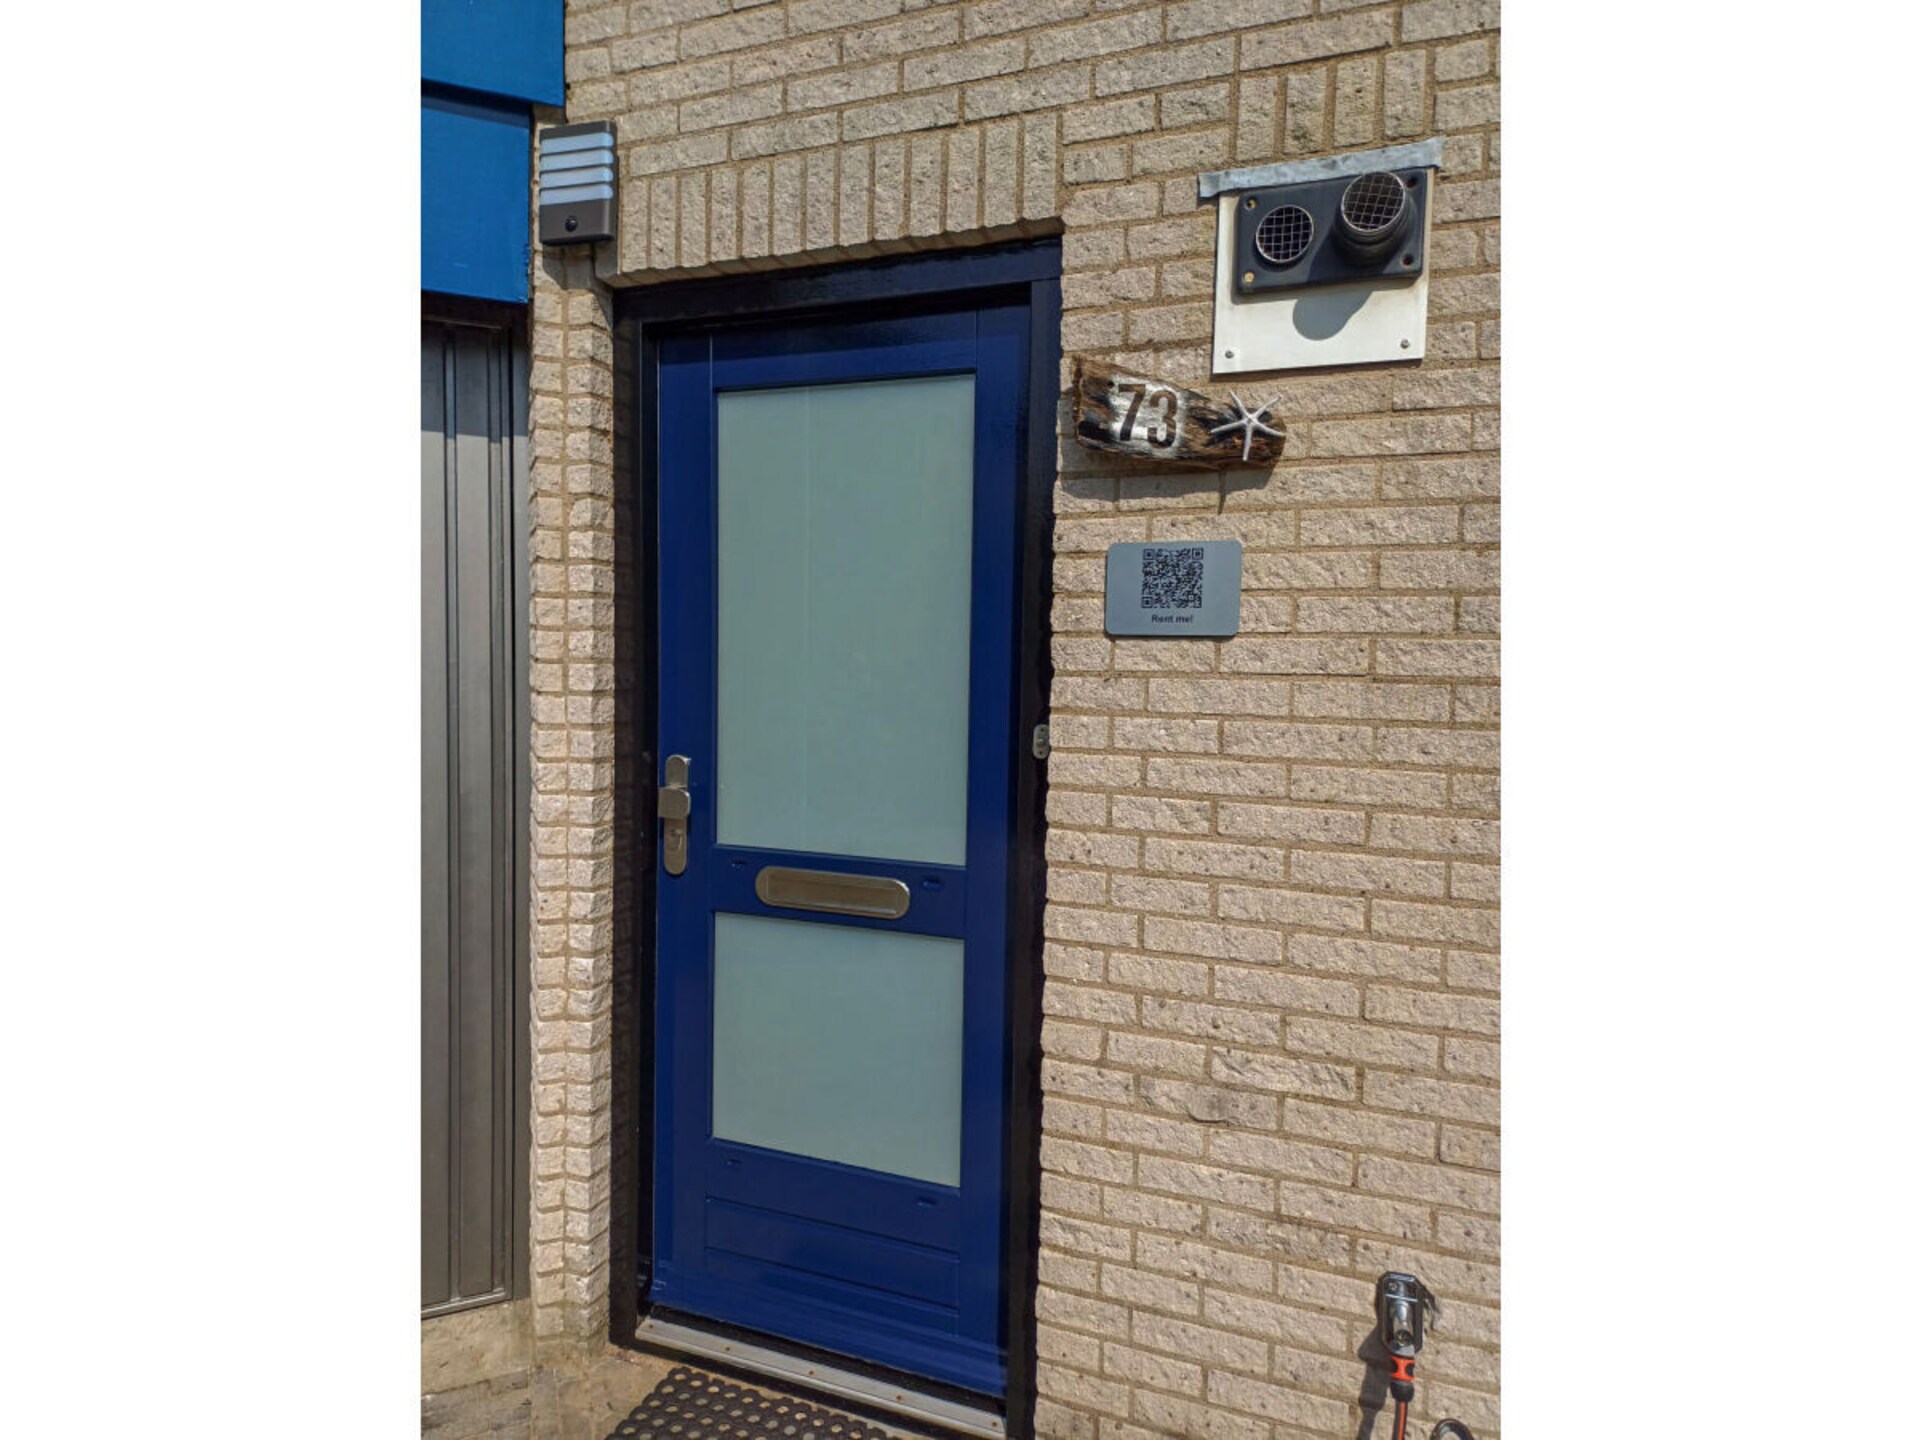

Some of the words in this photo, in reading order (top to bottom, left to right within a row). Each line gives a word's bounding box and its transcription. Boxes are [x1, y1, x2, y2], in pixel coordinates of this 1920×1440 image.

[1118, 384, 1177, 448] 73
[1151, 614, 1174, 623] Rent
[1175, 614, 1194, 623] me!
